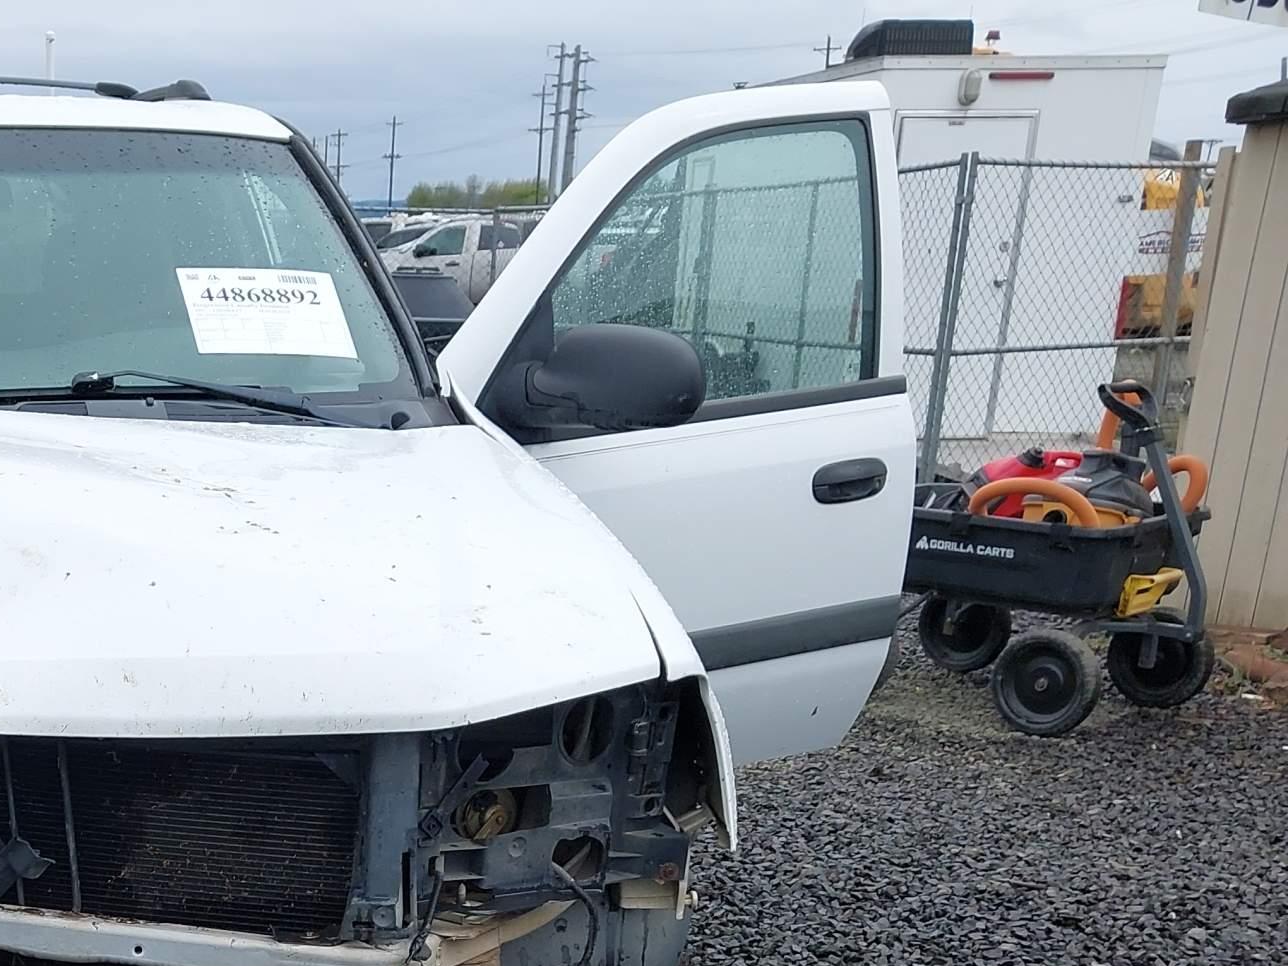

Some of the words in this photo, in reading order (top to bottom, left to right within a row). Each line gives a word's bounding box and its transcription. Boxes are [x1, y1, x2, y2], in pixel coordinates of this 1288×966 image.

[200, 287, 321, 305] 44868892
[929, 538, 974, 554] GORILLA
[976, 545, 1015, 559] CARTS
